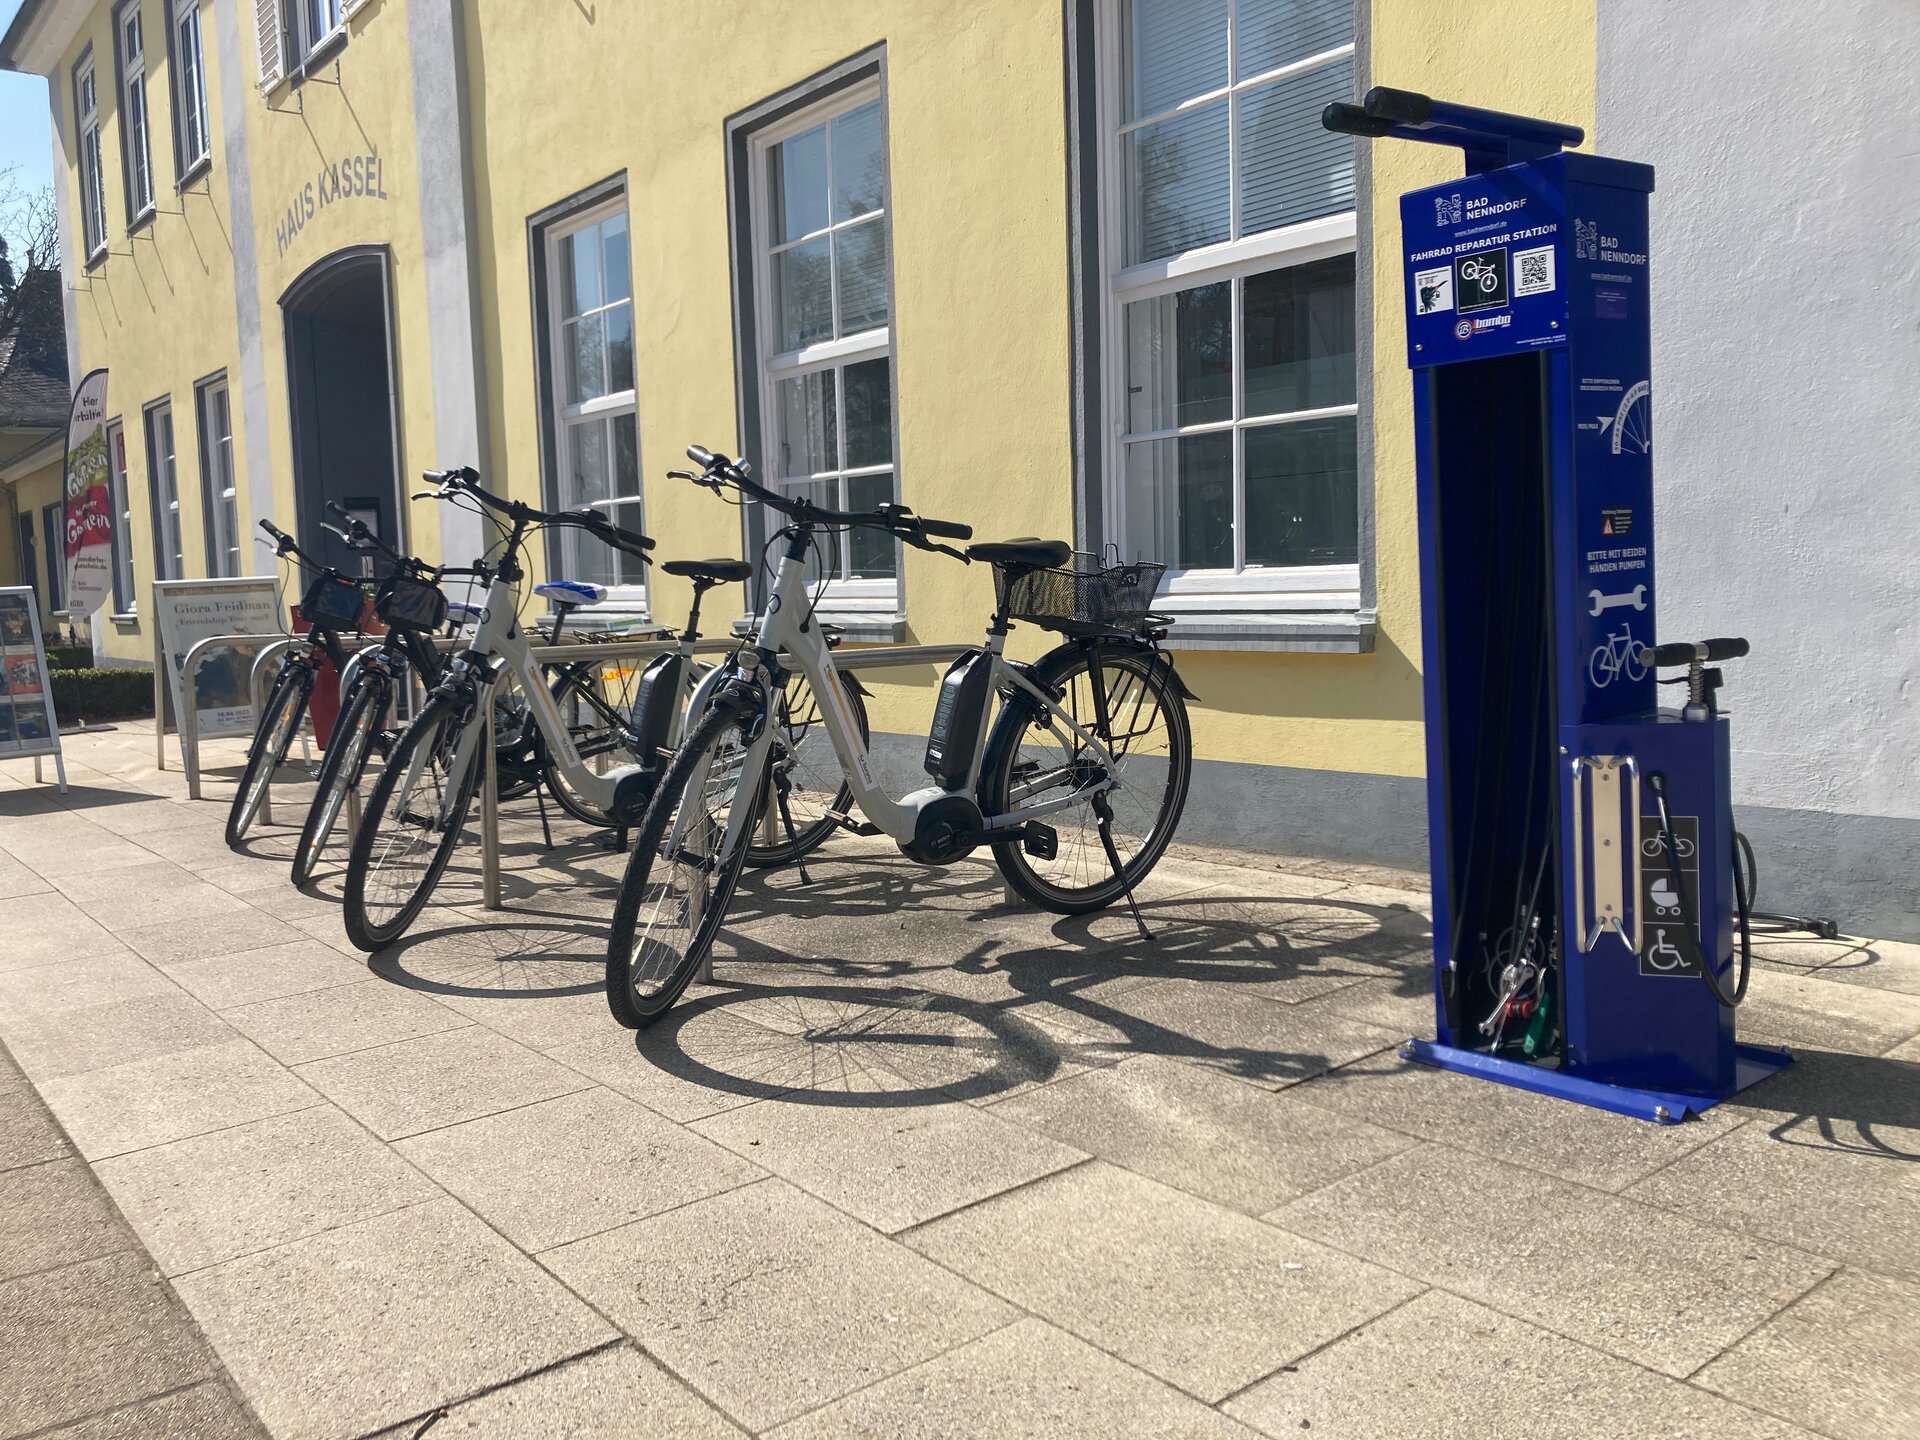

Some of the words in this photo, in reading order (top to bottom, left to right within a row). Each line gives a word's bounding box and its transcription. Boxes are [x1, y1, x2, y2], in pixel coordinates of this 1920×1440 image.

[276, 182, 315, 259] HAUS
[318, 155, 388, 209] KASSEL
[1466, 197, 1489, 210] BAD
[1466, 198, 1528, 221] NENNDORF
[1410, 246, 1453, 262] FAHRRAD
[1455, 233, 1511, 253] REPARATUR
[1513, 223, 1558, 241] STATION
[1600, 236, 1619, 249] BAD
[1600, 250, 1647, 265] NENNDORF
[1587, 550, 1607, 561] BITTE
[1608, 549, 1622, 559] MIT
[1622, 547, 1647, 558] BEIDEN
[1589, 561, 1618, 574] HÄNDEN
[1618, 559, 1646, 571] PUMPEN
[173, 602, 212, 615] Giora
[215, 599, 271, 613] Feidman
